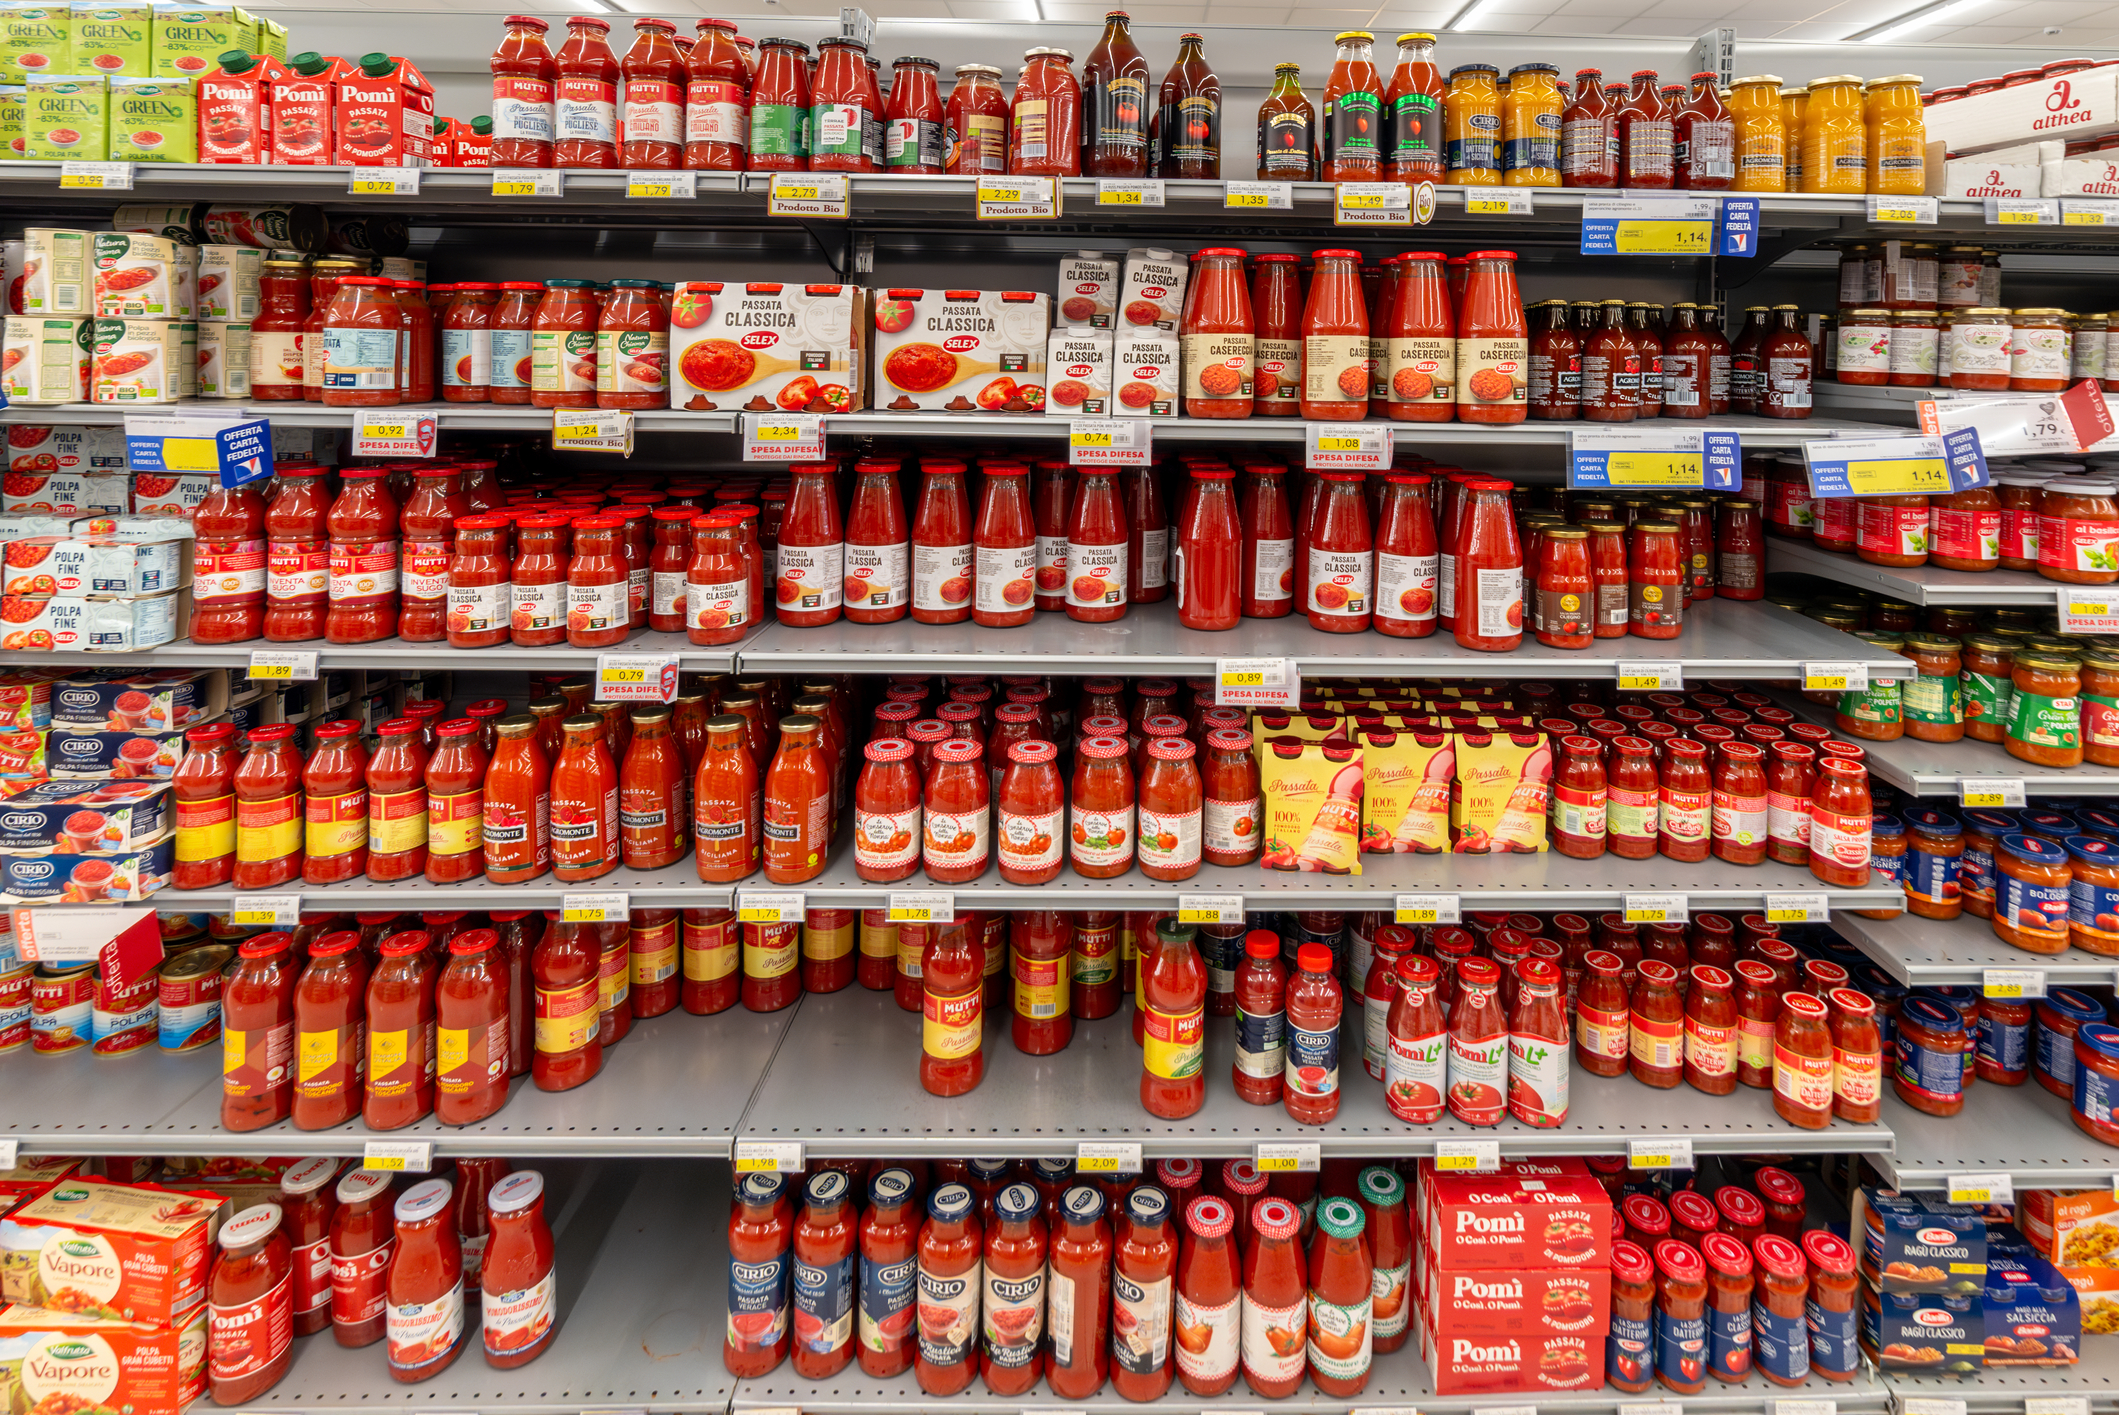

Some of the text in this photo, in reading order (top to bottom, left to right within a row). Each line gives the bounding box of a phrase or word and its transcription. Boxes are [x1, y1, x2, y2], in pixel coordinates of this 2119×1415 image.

[8, 23, 56, 38] GREEN
[82, 25, 131, 39] GREEN
[166, 27, 217, 41] GREEN
[565, 80, 598, 91] MUTTI
[274, 85, 324, 102] Pomì
[341, 86, 395, 103] Pomì
[39, 98, 89, 112] GREEN
[2033, 109, 2092, 131] althea
[513, 119, 549, 133] PUGLIESE
[1745, 156, 1782, 165] AGROMONTE
[78, 176, 103, 186] 0,99
[367, 181, 391, 191] 0,72
[509, 184, 533, 195] 1,79
[644, 186, 668, 197] 1,79
[791, 187, 816, 198] 2,79
[994, 189, 1019, 200] 2,29
[1116, 193, 1140, 204] 1,34
[1240, 195, 1264, 205] 1,35
[1358, 196, 1381, 207] 1,49
[778, 203, 840, 214] Prodotto Bio
[986, 205, 1048, 215] Prodotto Bio
[1889, 209, 1913, 219] 2,06
[1344, 212, 1405, 222] Prodotto Bio
[1730, 212, 1749, 220] CARTA
[2012, 213, 2033, 222] 1,32
[2080, 215, 2101, 224] 1,32
[1726, 221, 1751, 230] FEDELTÀ
[1133, 273, 1179, 288] CLASSICA
[725, 312, 796, 328] CLASSICA
[927, 317, 995, 332] CLASSICA
[1056, 350, 1103, 364] CLASSICA
[1123, 352, 1171, 366] CLASSICA
[1480, 349, 1526, 360] CASERECCIA
[2086, 379, 2112, 434] offerta
[223, 426, 263, 442] OFFERTA
[378, 426, 402, 436] 0,92
[573, 426, 597, 437] 1,24
[773, 426, 797, 436] 2,34
[1084, 432, 1108, 443] 0,74
[230, 437, 259, 451] CARTA
[608, 439, 624, 448] Bio
[1336, 438, 1359, 449] 1,08
[1953, 441, 1973, 456] CARTA
[227, 445, 264, 462] FEDELTÀ
[1077, 450, 1145, 459] SPESA DIFESA
[1712, 446, 1731, 454] CARTA
[1313, 454, 1380, 463] SPESA DIFESA
[1710, 456, 1734, 465] FEDELTÀ
[1953, 451, 1978, 466] FEDELTÀ
[2074, 537, 2098, 546] SELEX
[784, 550, 808, 559] PASSATA
[1330, 556, 1357, 564] PASSATA
[57, 563, 79, 574] FINE
[1090, 568, 1110, 578] SELEX
[417, 584, 443, 592] SUGO
[714, 601, 731, 610] SELEX
[54, 617, 76, 628] FINE
[266, 666, 289, 676] 1,89
[619, 670, 643, 681] 0,79
[1237, 673, 1261, 684] 0,89
[1634, 677, 1657, 687] 1,49
[1820, 678, 1845, 688] 1,49
[64, 693, 95, 703] CIRIO
[1222, 690, 1289, 699] SPESA DIFESA
[1367, 766, 1415, 783] Passata
[1467, 766, 1513, 785] Passata
[1269, 778, 1319, 795] Passata
[1469, 797, 1495, 808] 100%
[1979, 794, 2002, 803] 2,89
[250, 911, 274, 921] 1,39
[578, 909, 602, 920] 1,75
[756, 909, 779, 919] 1,75
[905, 908, 928, 918] 1,78
[1195, 910, 1219, 920] 1,88
[1412, 910, 1435, 920] 1,89
[1641, 909, 1664, 920] 1,75
[1781, 909, 1804, 920] 1,75
[17, 912, 36, 958] offerta
[764, 923, 796, 937] MUTTI
[1997, 983, 2021, 993] 2,85
[944, 995, 980, 1013] MUTTI
[110, 1009, 153, 1028] POLPA
[1388, 1034, 1424, 1062] Pomì
[1449, 1036, 1487, 1063] Pomì
[380, 1157, 403, 1167] 1,52
[752, 1158, 775, 1168] 1,98
[1092, 1159, 1116, 1169] 2,09
[1272, 1159, 1295, 1168] 1,00
[1452, 1156, 1475, 1166] 1,29
[1456, 1211, 1525, 1233] Pomì
[1925, 1231, 1953, 1242] Barilla
[62, 1241, 99, 1257] Valfrutto
[1905, 1244, 1968, 1258] RAGÙ CLASSICO
[135, 1253, 156, 1263] POLPA
[46, 1254, 115, 1279] Vapore
[735, 1264, 777, 1281] CIRIO
[919, 1279, 963, 1295] CIRIO
[994, 1278, 1039, 1297] CIRIO
[1454, 1277, 1523, 1298] Pomì
[486, 1294, 543, 1319] POMODORISSIMO
[738, 1302, 767, 1311] VERACE
[1923, 1313, 1950, 1323] Barilla
[2006, 1313, 2057, 1323] SALSICCIA
[1543, 1337, 1586, 1352] PASSATA
[50, 1344, 94, 1358] Valfrutto
[1453, 1339, 1521, 1363] Pomì
[122, 1355, 174, 1366] GRAN CUBETTI
[31, 1358, 111, 1380] Vapore
